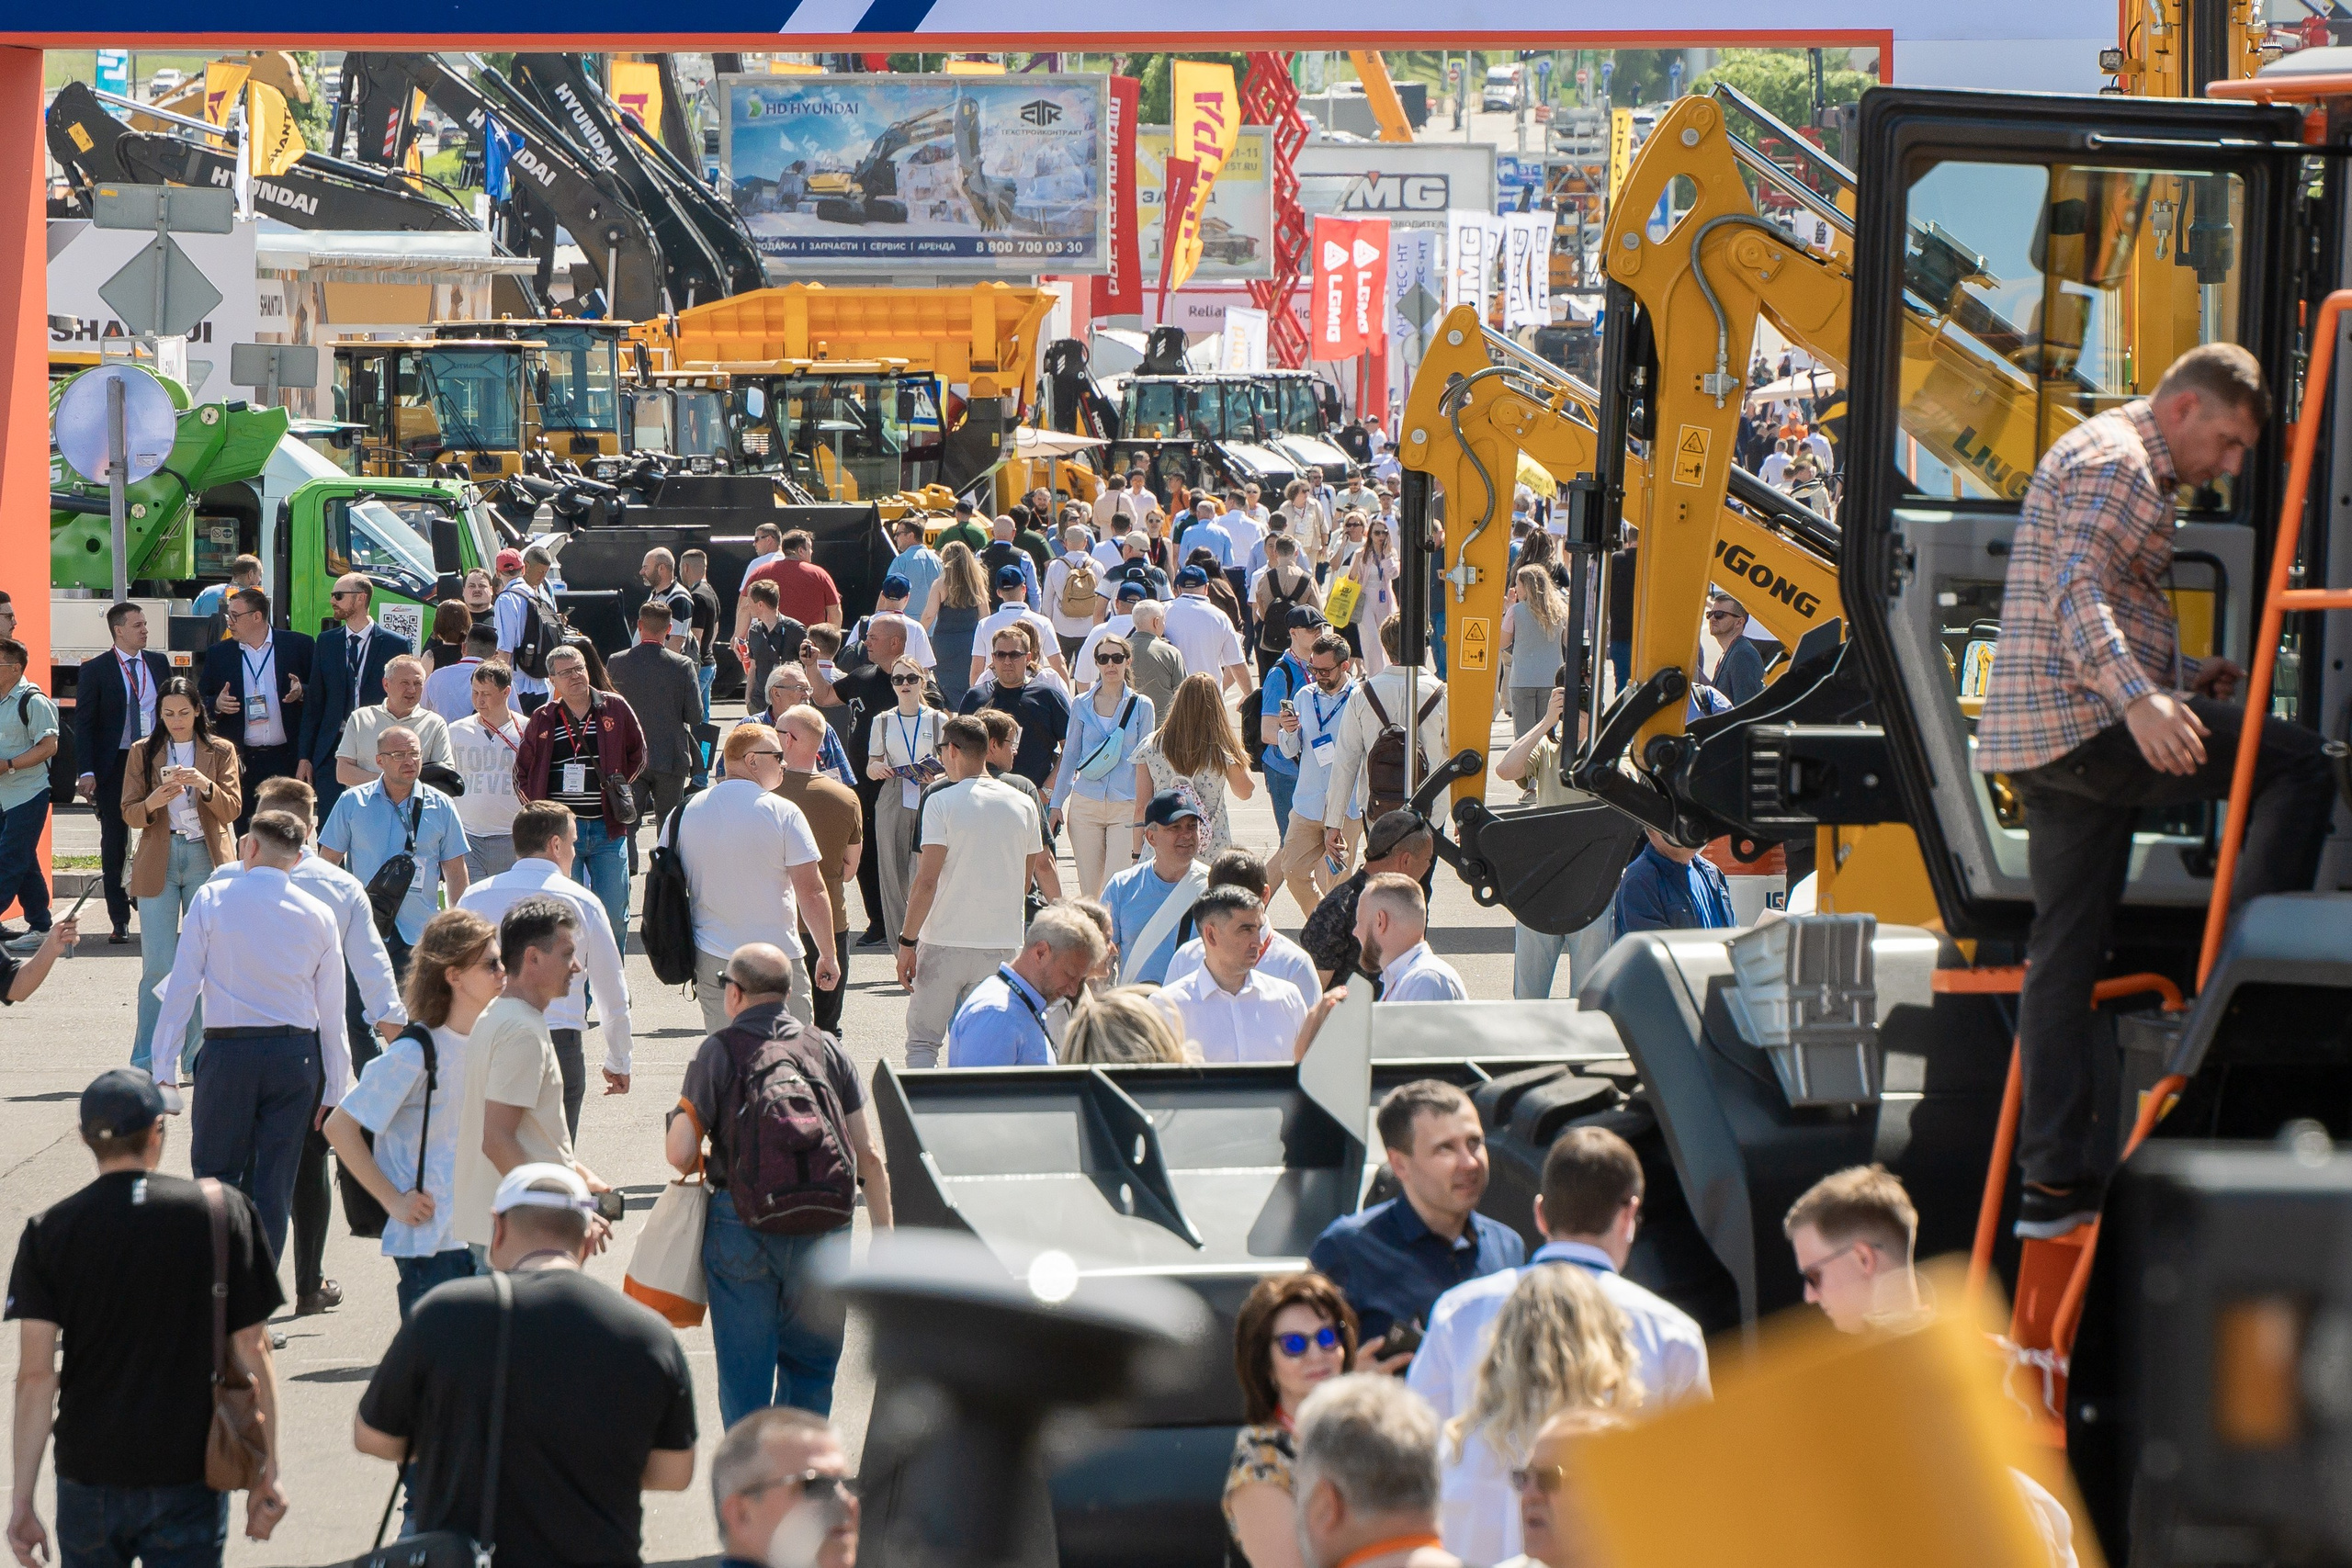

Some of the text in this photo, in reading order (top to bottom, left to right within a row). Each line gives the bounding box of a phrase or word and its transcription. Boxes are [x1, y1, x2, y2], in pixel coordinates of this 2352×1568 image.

[554, 82, 618, 168] HYUNDAI
[765, 103, 859, 115] HD HYUNDAI
[466, 107, 558, 187] HDAI
[756, 241, 1083, 253] РОДАЖА ЗАПЧАСТИ СЕРВИС АРЕНДА 8 800 700 03 30
[260, 294, 283, 317] SHANTUI
[1326, 274, 1343, 343] LGMG
[1356, 271, 1373, 335] LGMG
[51, 320, 212, 344] SHAUI
[1714, 539, 1821, 619] GONG
[456, 745, 514, 773] TODA
